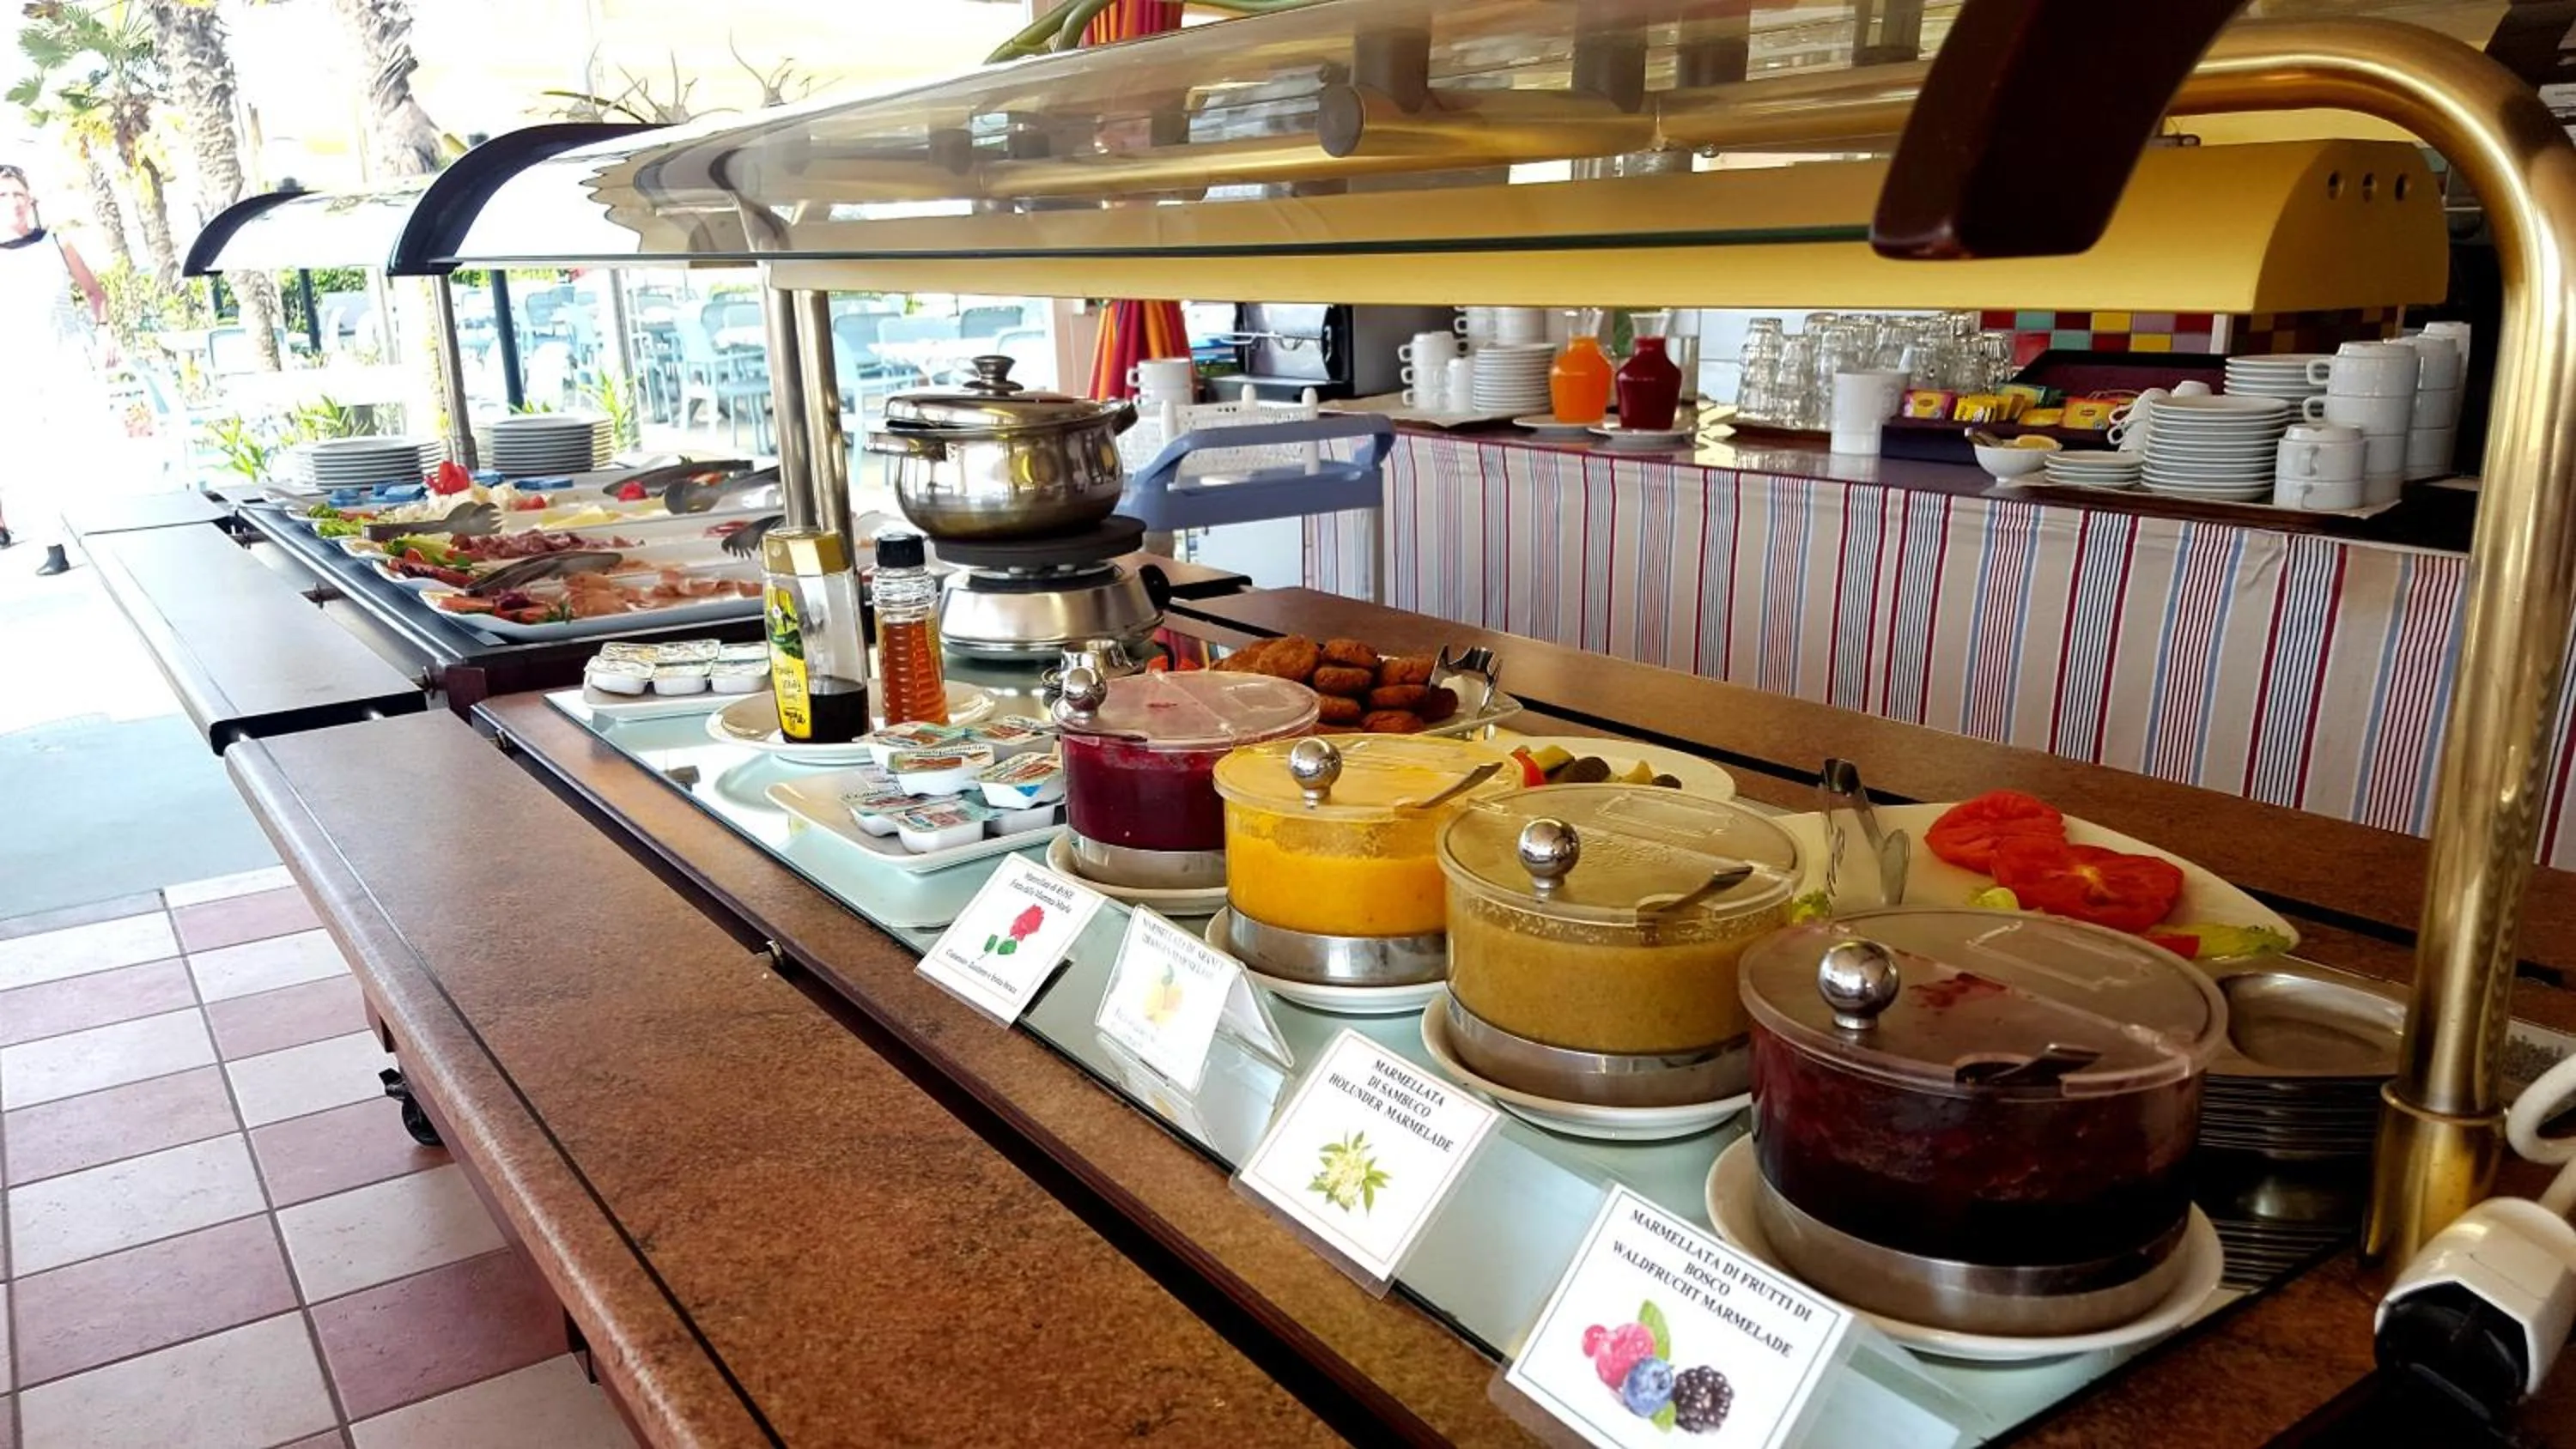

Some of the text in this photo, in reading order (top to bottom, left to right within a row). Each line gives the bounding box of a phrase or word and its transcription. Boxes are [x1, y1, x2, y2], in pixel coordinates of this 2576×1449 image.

[1328, 1073, 1455, 1153] HOLUNDER MARMELADE
[1367, 1075, 1432, 1118] DI SAMBUCO
[1373, 1058, 1445, 1107] MARMELLATA
[1630, 1209, 1814, 1323] MARMELLATA DI FRUTTI DI
[1683, 1261, 1731, 1297] BOSCO
[1613, 1240, 1794, 1358] WALDFRUCHT MARMELADE
